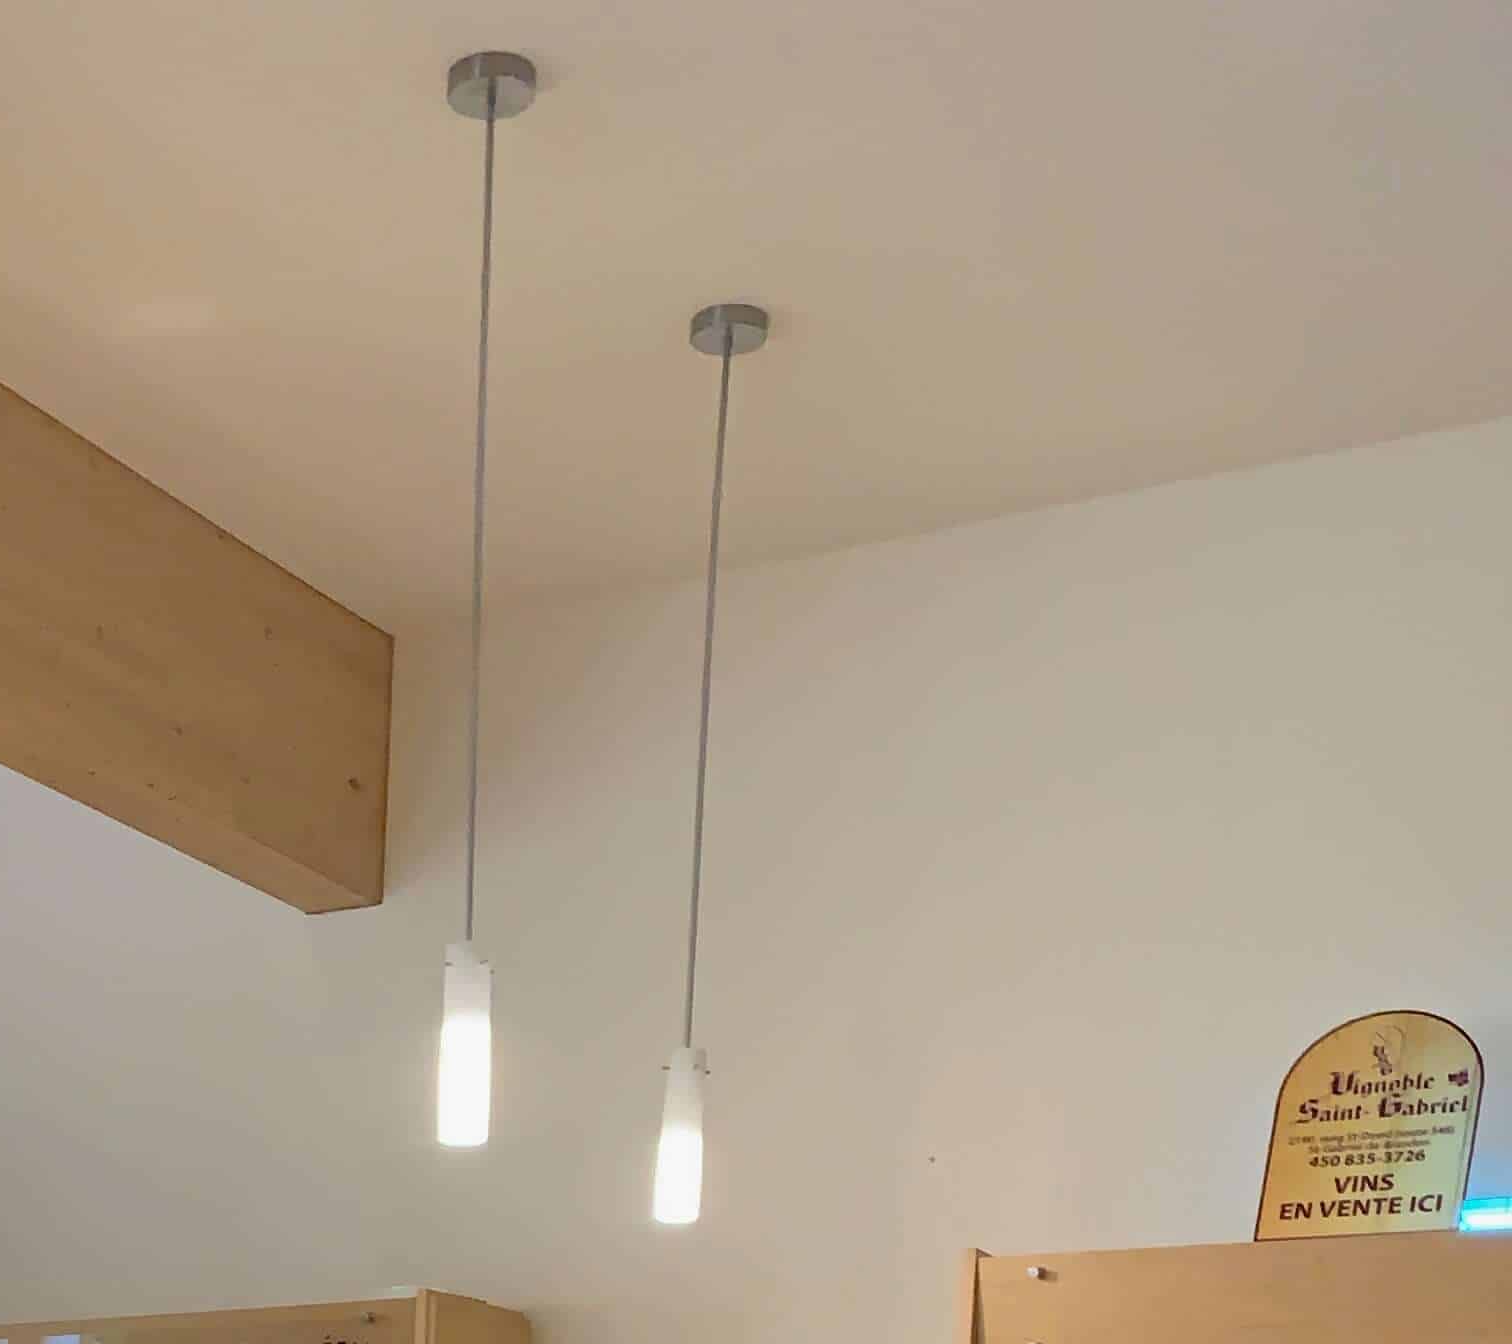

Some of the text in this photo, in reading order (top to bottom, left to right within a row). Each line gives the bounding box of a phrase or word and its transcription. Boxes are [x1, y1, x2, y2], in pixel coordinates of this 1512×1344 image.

[1329, 1070, 1436, 1098] Vignoble
[1308, 1155, 1341, 1168] 450
[1334, 1173, 1395, 1194] VINS
[1279, 1194, 1443, 1221] EN VENTE ICI
